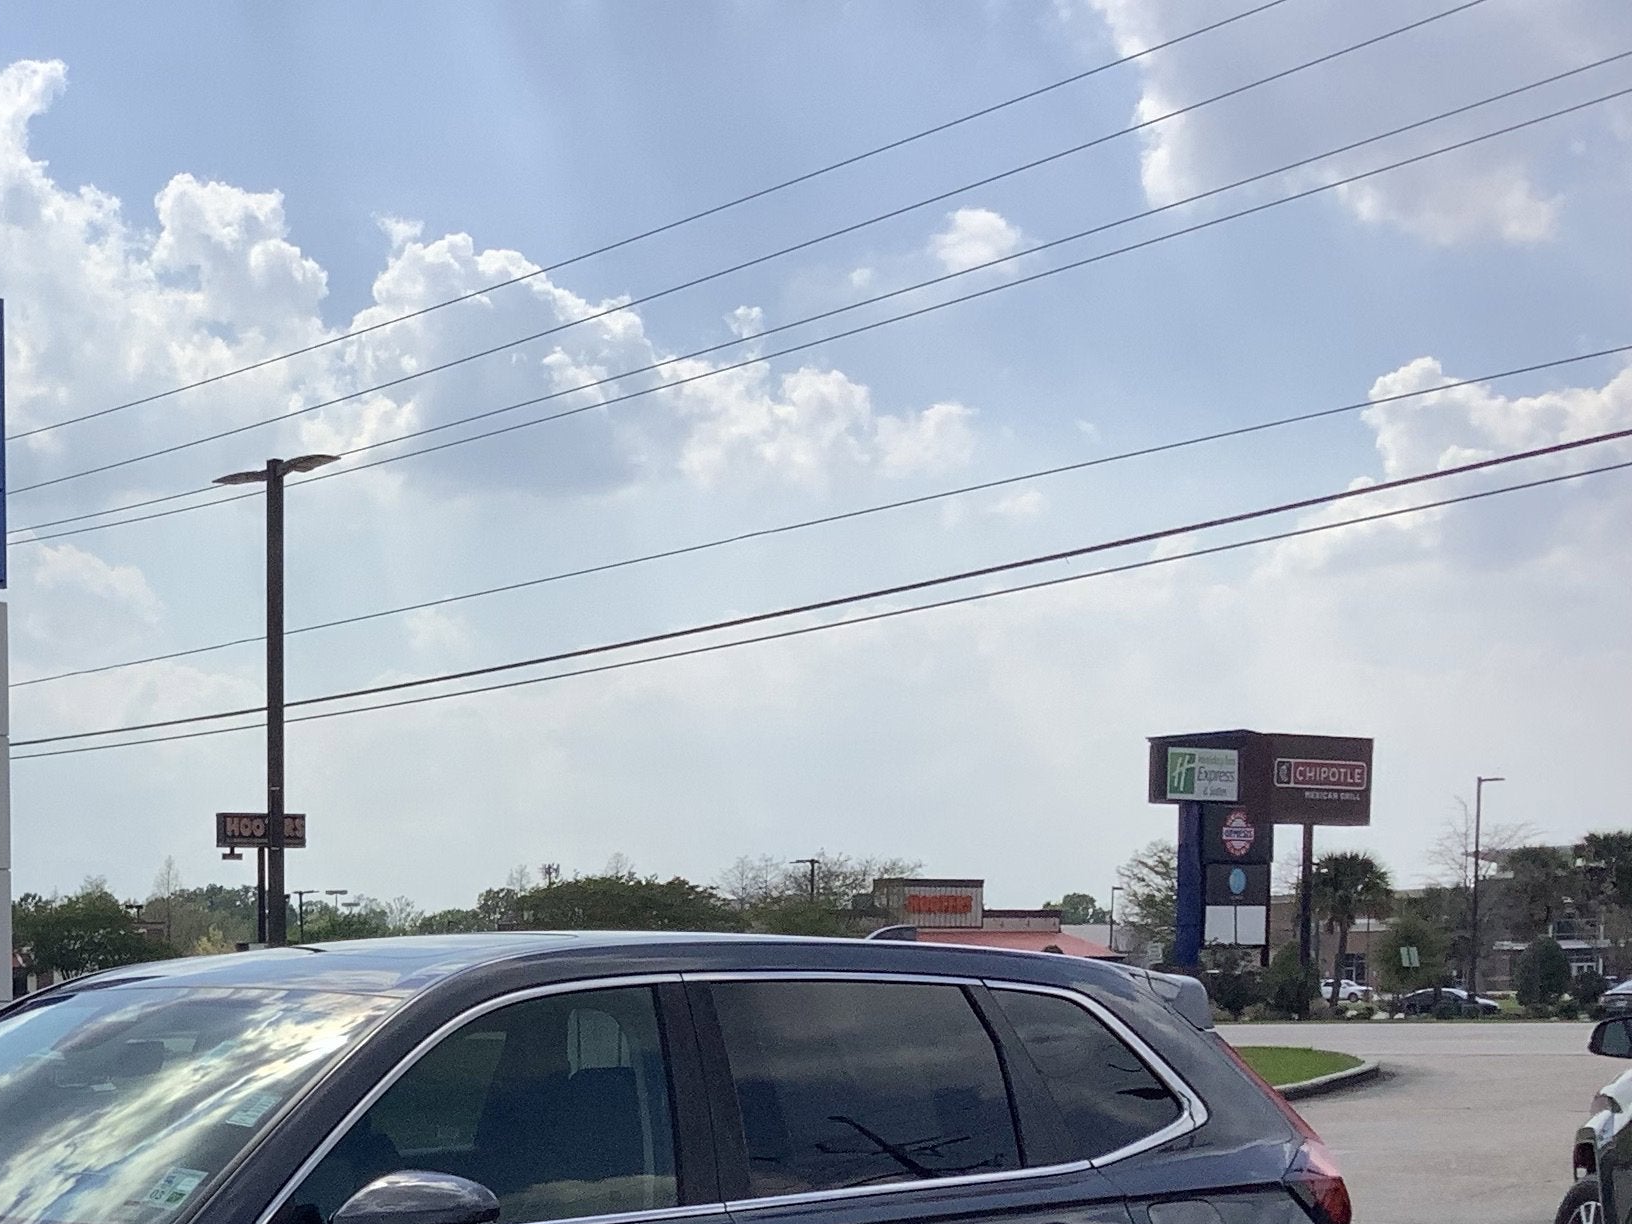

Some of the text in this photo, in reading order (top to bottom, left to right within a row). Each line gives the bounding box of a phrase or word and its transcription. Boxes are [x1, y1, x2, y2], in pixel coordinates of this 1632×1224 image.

[1197, 766, 1235, 783] Express
[1296, 766, 1363, 783] CHIPOTLE
[226, 817, 305, 838] HOORS
